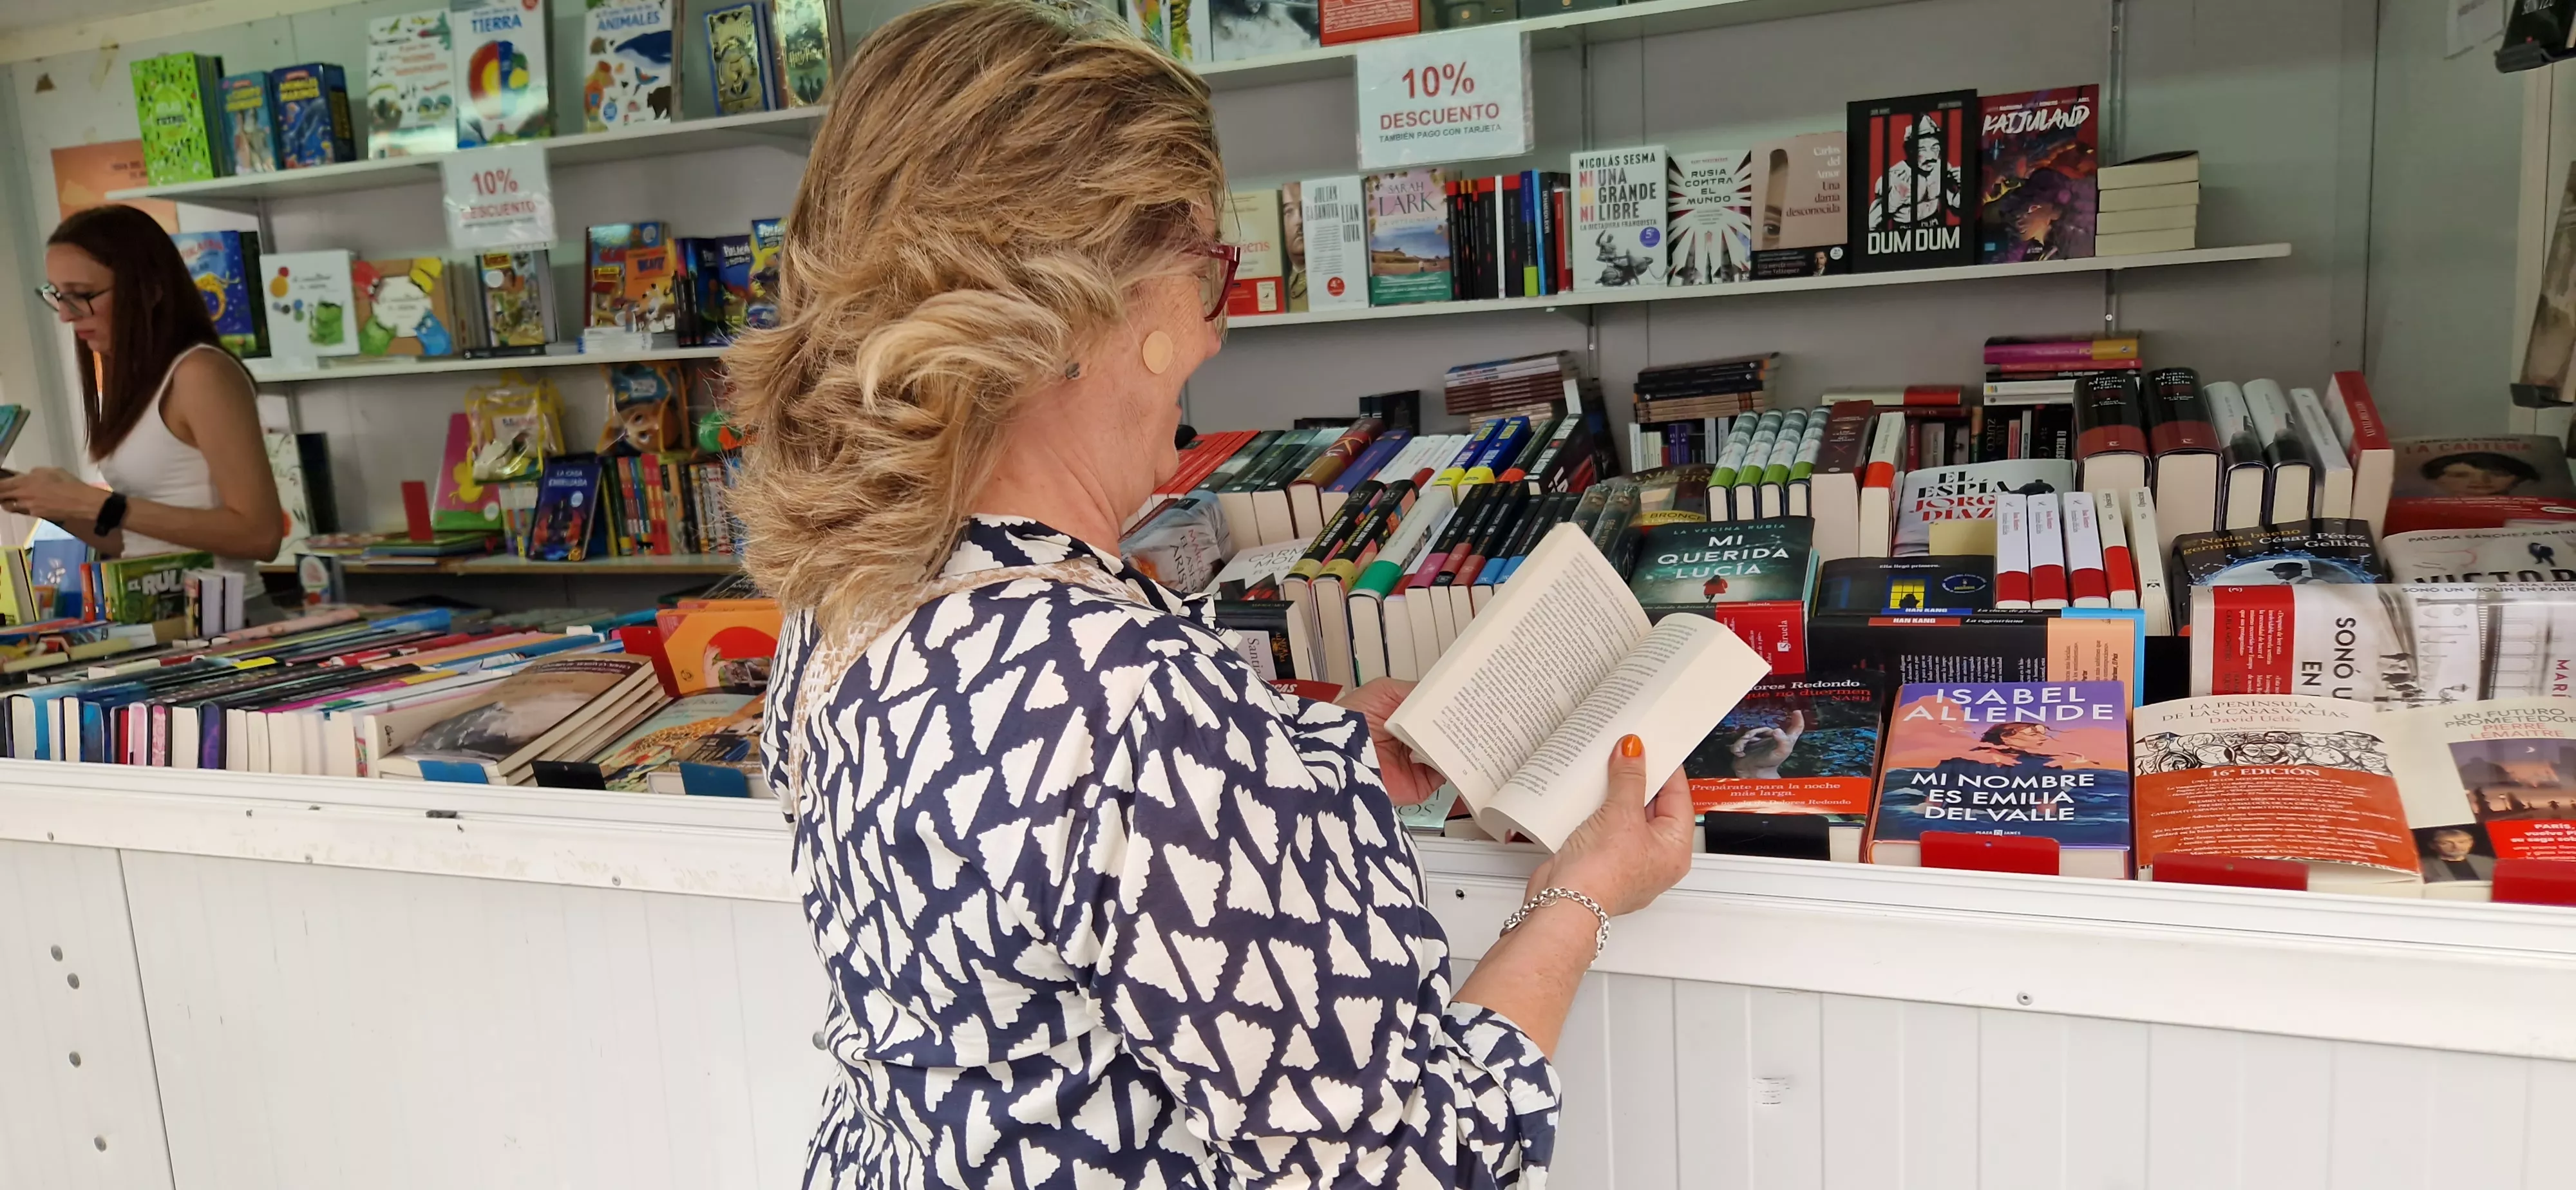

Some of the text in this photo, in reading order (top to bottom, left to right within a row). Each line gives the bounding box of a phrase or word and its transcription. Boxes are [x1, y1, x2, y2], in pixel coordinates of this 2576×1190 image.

[470, 14, 523, 33] TIERRA
[597, 10, 661, 32] ANIMALES
[1401, 61, 1475, 99] 10%
[1379, 102, 1501, 131] DESCUENTO
[1982, 104, 2091, 137] KAIJULAND
[1378, 123, 1502, 144] TAMBIÉN PAGO CON TARJETA
[1814, 146, 1841, 156] Carlos
[1578, 152, 1656, 170] NICOLÁS SESMA
[1826, 156, 1841, 167] del
[1579, 167, 1627, 189] NI UNA
[1690, 168, 1727, 178] RUSIA
[1816, 169, 1841, 179] Amor
[472, 167, 519, 196] 10%
[1387, 182, 1425, 194] SARAH
[1684, 177, 1733, 188] CONTRA
[1822, 181, 1841, 191] Una
[1598, 182, 1657, 204] GRANDE
[1686, 195, 1731, 205] MUNDO
[1814, 193, 1841, 203] dama
[1378, 193, 1437, 216] LARK
[1580, 202, 1640, 223] NI LIBRE
[1786, 203, 1841, 218] desconocida
[1622, 219, 1657, 228] FRANQUISTA
[1868, 226, 1960, 255] DUM DUM
[2405, 443, 2428, 454] LA
[1938, 471, 1975, 484] EL
[1917, 479, 2011, 498] ESPÍA
[1908, 495, 1996, 513] JORG
[1921, 507, 1994, 521] DÍAZ
[1694, 525, 1739, 534] VECINA
[2200, 527, 2302, 545] Nada bueno
[2464, 532, 2528, 541] SÁNCHEZ
[2531, 529, 2576, 537] GARNI
[1708, 534, 1743, 547] MI
[2183, 538, 2253, 554] germina
[2258, 531, 2365, 545] César Pérez
[2304, 537, 2371, 549] Gellida
[1188, 528, 1207, 590] MARCOS
[1248, 547, 1304, 563] CARM
[1255, 556, 1297, 568] MOL
[1657, 547, 1789, 565] QUERIDA
[1180, 534, 1198, 593] EL ASES
[1675, 563, 1763, 580] LUCÍA
[1777, 619, 1792, 652] Siruela
[1247, 637, 1262, 677] Santia
[2332, 617, 2362, 699] SONÓ U
[2301, 661, 2323, 686] EN
[2552, 659, 2572, 698] MARÍ
[1273, 683, 1298, 694] CAS
[1790, 679, 1861, 689] Redondo
[1936, 686, 2086, 705] ISABEL
[2216, 699, 2316, 709] PENÍNSULA
[1903, 704, 2114, 723] ALLENDE
[2162, 707, 2350, 722] DE LAS CASAS VACÍAS
[2209, 715, 2301, 724] David Uclés
[2453, 708, 2566, 721] UN FUTURO
[2470, 730, 2566, 740] LEMAITRE
[2483, 722, 2546, 732] PIERRE
[2210, 766, 2320, 777] 16ª EDICIÓN
[1690, 783, 1752, 792] Prepárate
[1911, 771, 2095, 789] MI NOMBRE
[1759, 789, 1796, 798] larga.
[1928, 789, 2075, 806] ES EMILIA
[1924, 806, 2075, 822] DEL VALLE
